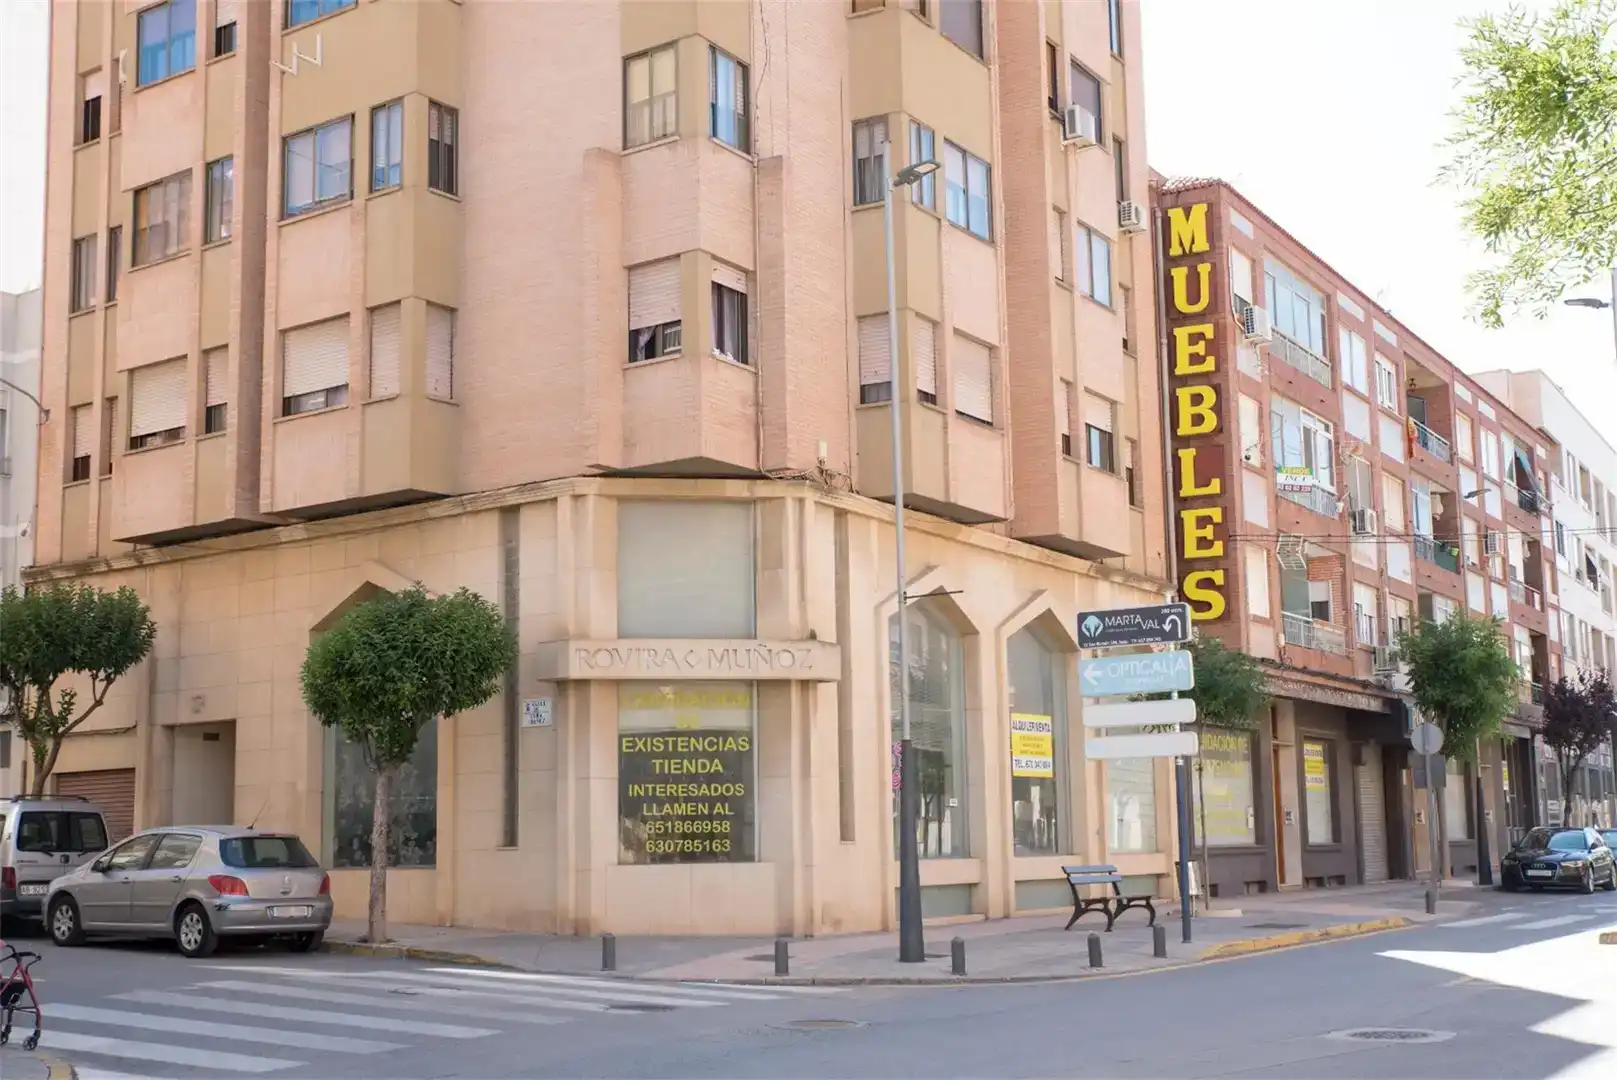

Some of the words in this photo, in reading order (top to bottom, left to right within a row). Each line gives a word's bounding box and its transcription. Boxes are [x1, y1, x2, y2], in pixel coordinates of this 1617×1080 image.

[1166, 202, 1226, 621] MUEBLES
[1105, 614, 1142, 627] MARTA
[1140, 619, 1161, 630] VAL
[574, 647, 680, 671] ROVIRA
[707, 643, 812, 670] MUÑOZ
[622, 736, 750, 752] EXISTENCIAS
[652, 759, 724, 774] TIENDA
[628, 783, 745, 797] INTERESADOS
[643, 803, 709, 815] LLAMEN
[713, 803, 735, 815] AL
[645, 820, 731, 833] 651866958
[645, 839, 731, 853] 630785163
